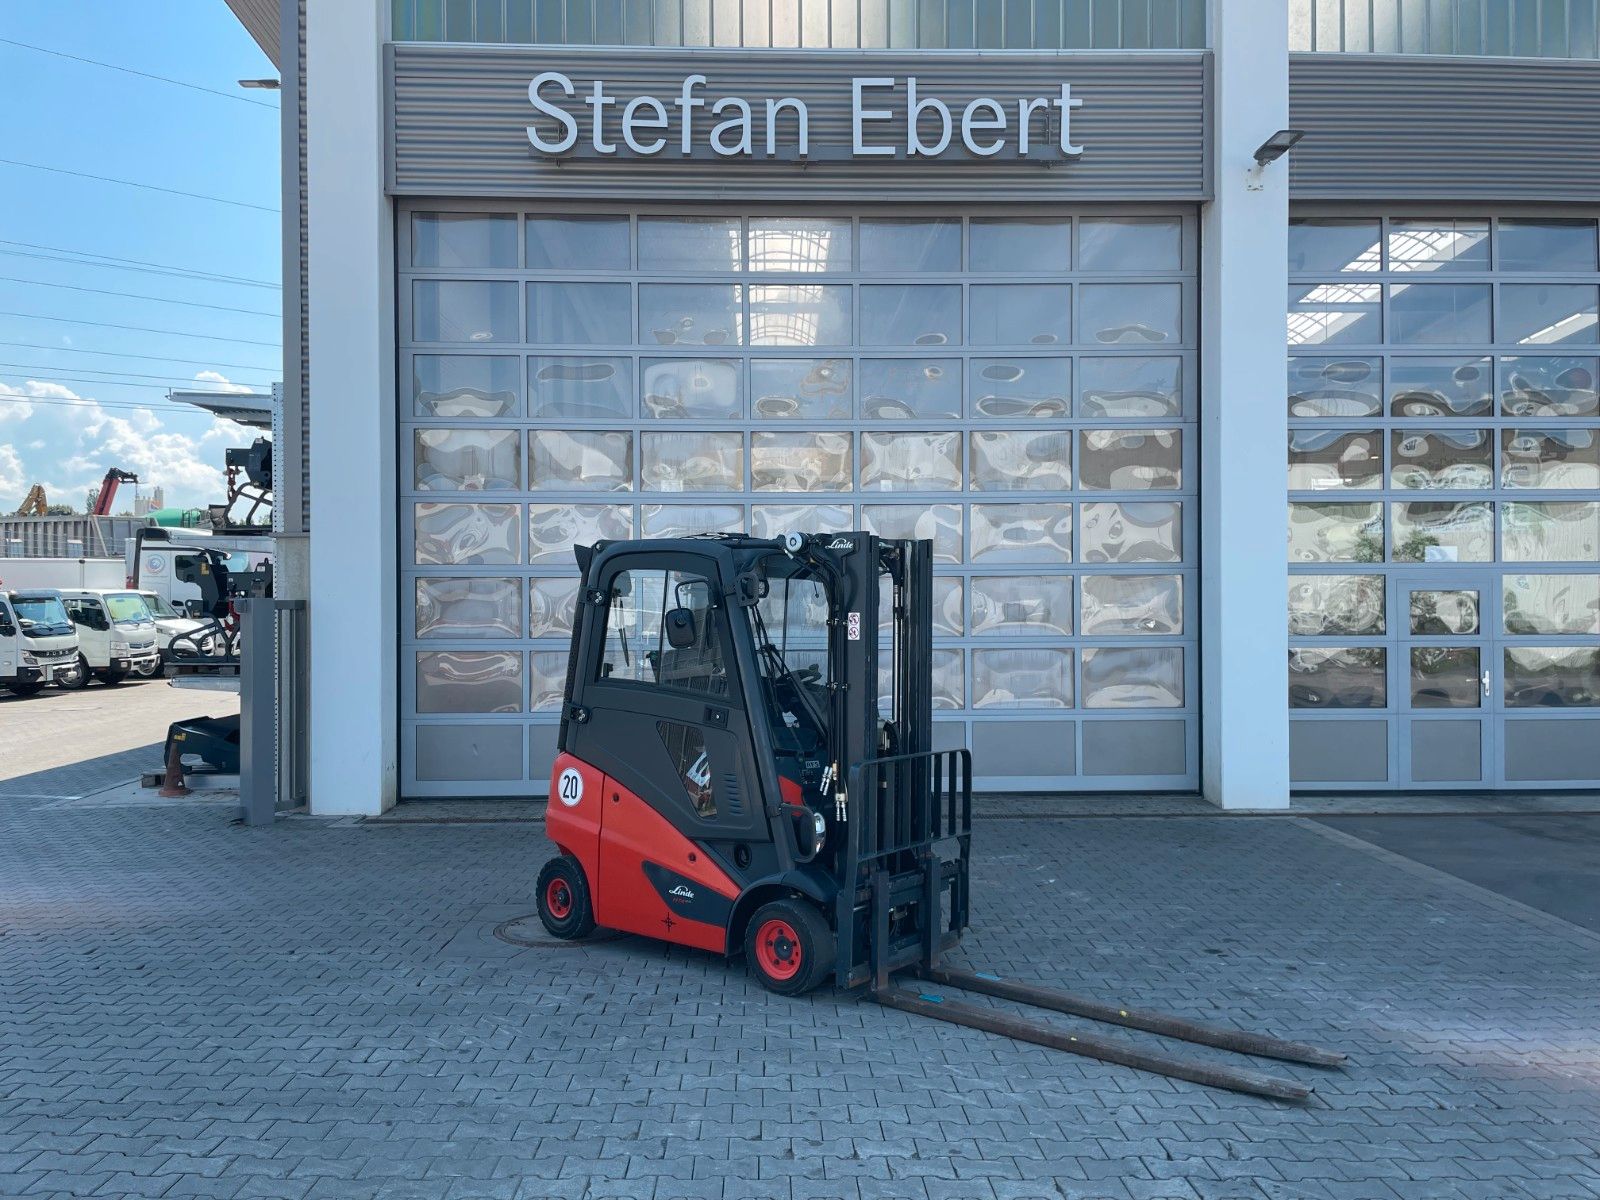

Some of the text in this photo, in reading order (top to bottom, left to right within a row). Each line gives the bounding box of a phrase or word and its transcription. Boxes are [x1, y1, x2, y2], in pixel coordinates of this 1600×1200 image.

[526, 71, 1084, 157] Stefan Ebert
[825, 537, 854, 550] Linde
[563, 774, 578, 799] 20
[668, 885, 695, 899] Linde
